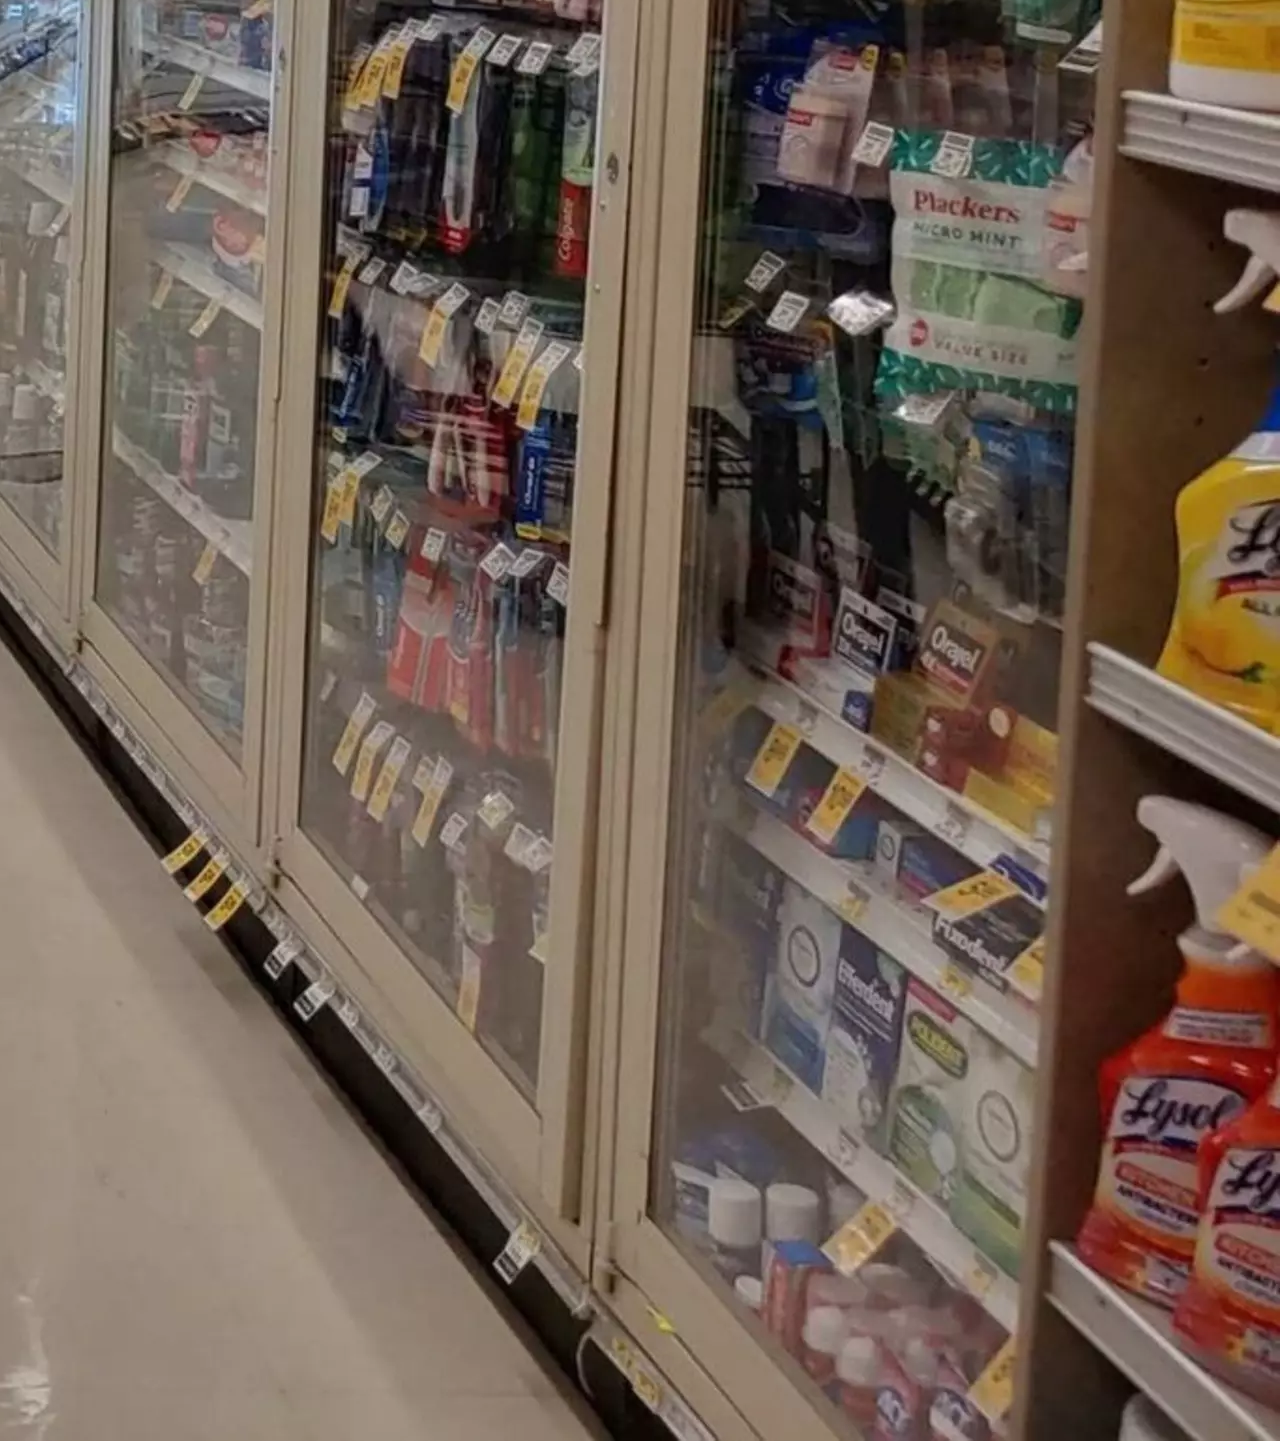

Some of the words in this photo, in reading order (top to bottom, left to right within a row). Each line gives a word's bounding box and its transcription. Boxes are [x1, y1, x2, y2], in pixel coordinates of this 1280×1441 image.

[913, 189, 1022, 224] Plackers
[913, 221, 964, 240] MICRO
[970, 230, 1023, 249] MINT
[933, 340, 984, 358] VALUE
[992, 347, 1029, 366] SIZE
[931, 626, 982, 674] Orajel
[934, 918, 1009, 973] Fixodent
[1121, 1079, 1239, 1138] Lysol
